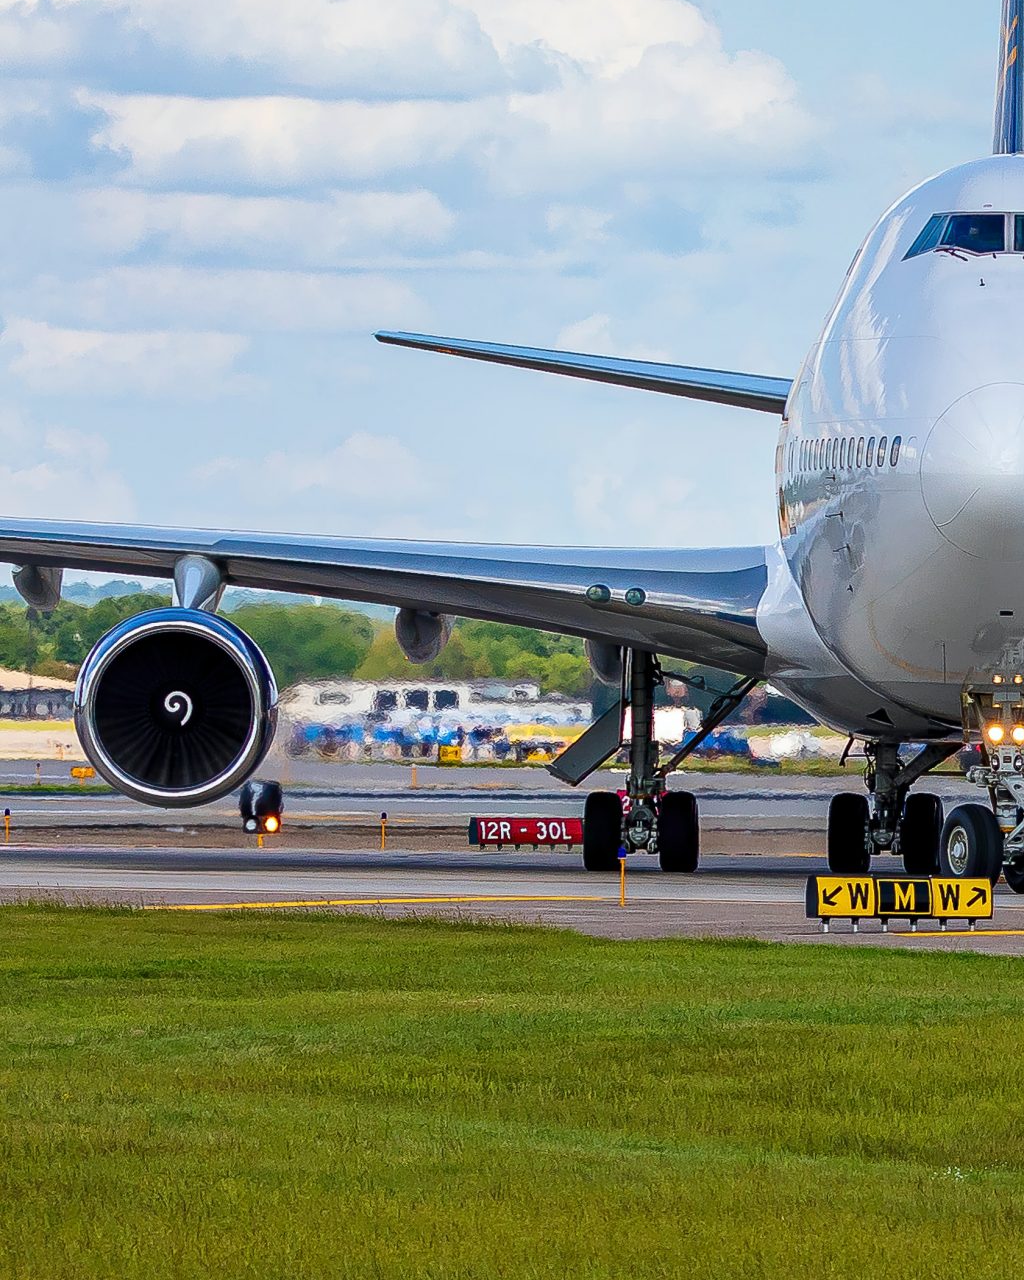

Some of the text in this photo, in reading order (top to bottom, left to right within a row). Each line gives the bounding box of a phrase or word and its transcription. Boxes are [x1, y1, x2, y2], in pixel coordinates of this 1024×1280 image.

[480, 821, 511, 840] 12R
[537, 822, 572, 840] 30L
[848, 883, 960, 911] W M W
